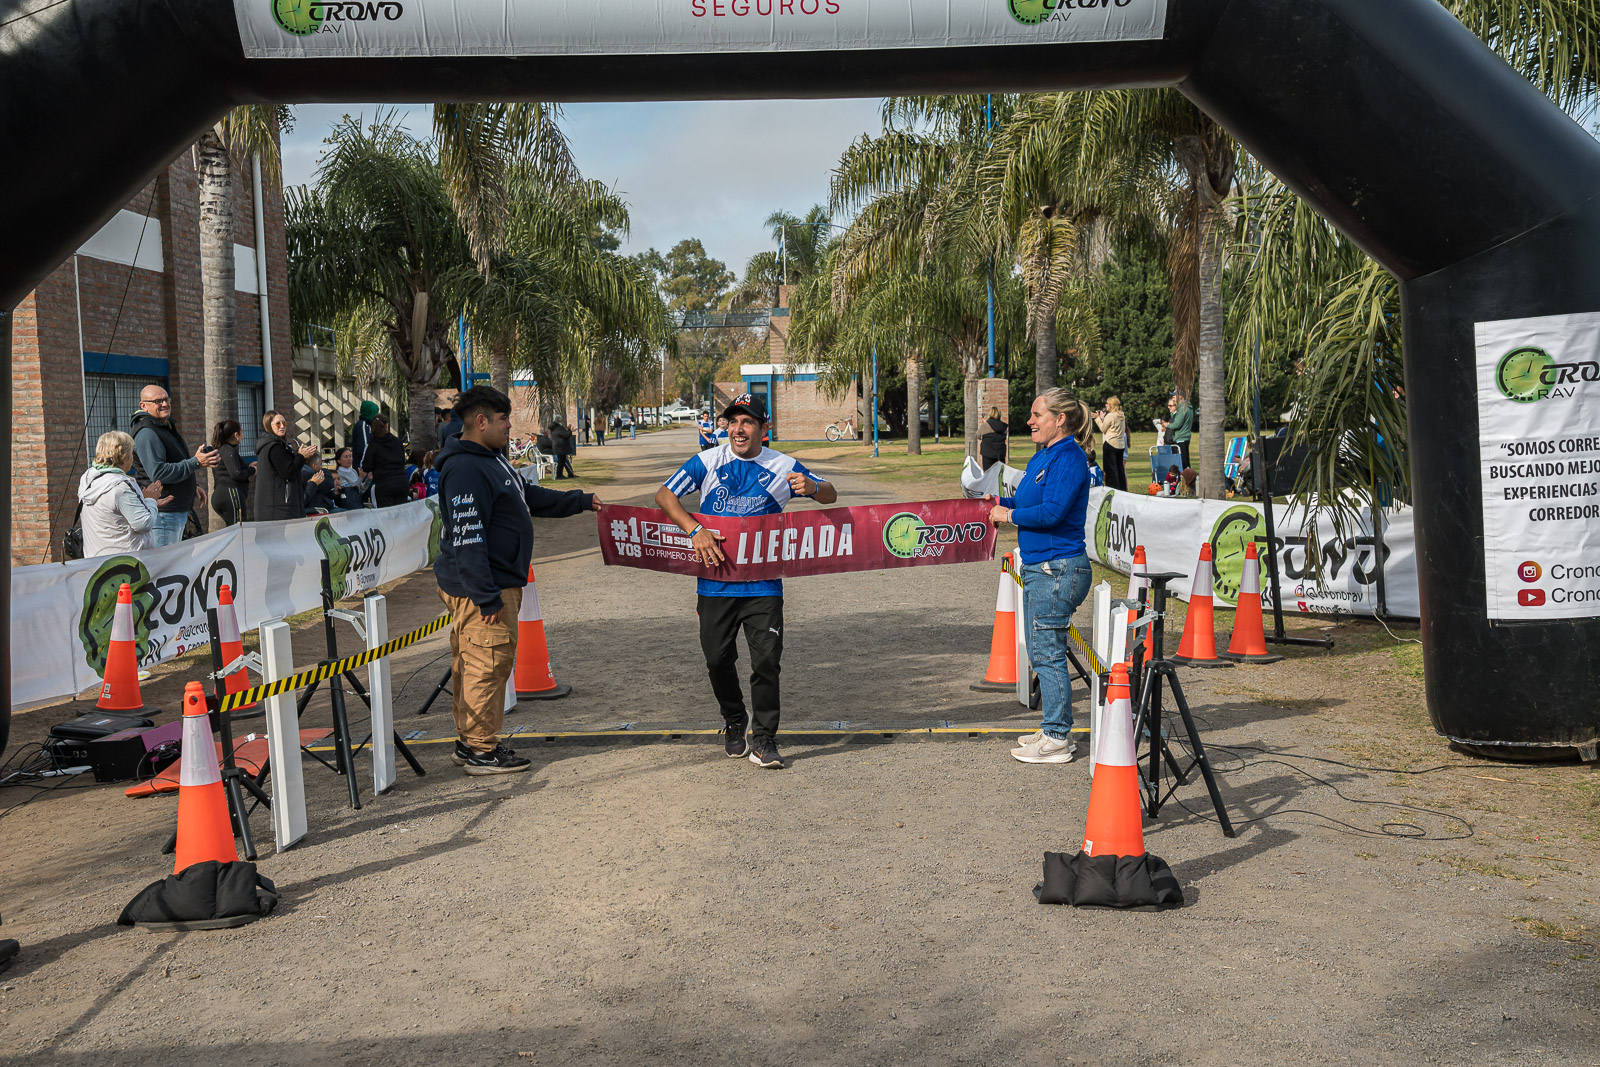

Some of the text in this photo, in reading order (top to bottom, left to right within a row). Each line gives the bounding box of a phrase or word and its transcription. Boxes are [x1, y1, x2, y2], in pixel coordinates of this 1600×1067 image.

[308, 1, 404, 21] CRONO
[691, 0, 840, 17] SEGUROS
[1039, 12, 1072, 22] RAV
[309, 24, 342, 34] RAV
[1539, 360, 1600, 385] CRO
[1537, 387, 1576, 400] RAV
[1558, 437, 1600, 453] CORRE
[1490, 462, 1565, 479] BUSCANDO
[712, 486, 729, 513] 3
[1503, 482, 1598, 501] EXPERIENCIAS
[452, 495, 461, 506] El
[457, 507, 477, 522] pueblo
[1529, 505, 1600, 522] CORREDOR
[610, 516, 641, 544] #1
[615, 541, 642, 558] VOS
[736, 523, 854, 565] LLEGADA
[912, 545, 945, 558] RAV
[646, 548, 655, 557] LO
[656, 549, 687, 561] PRIMERO
